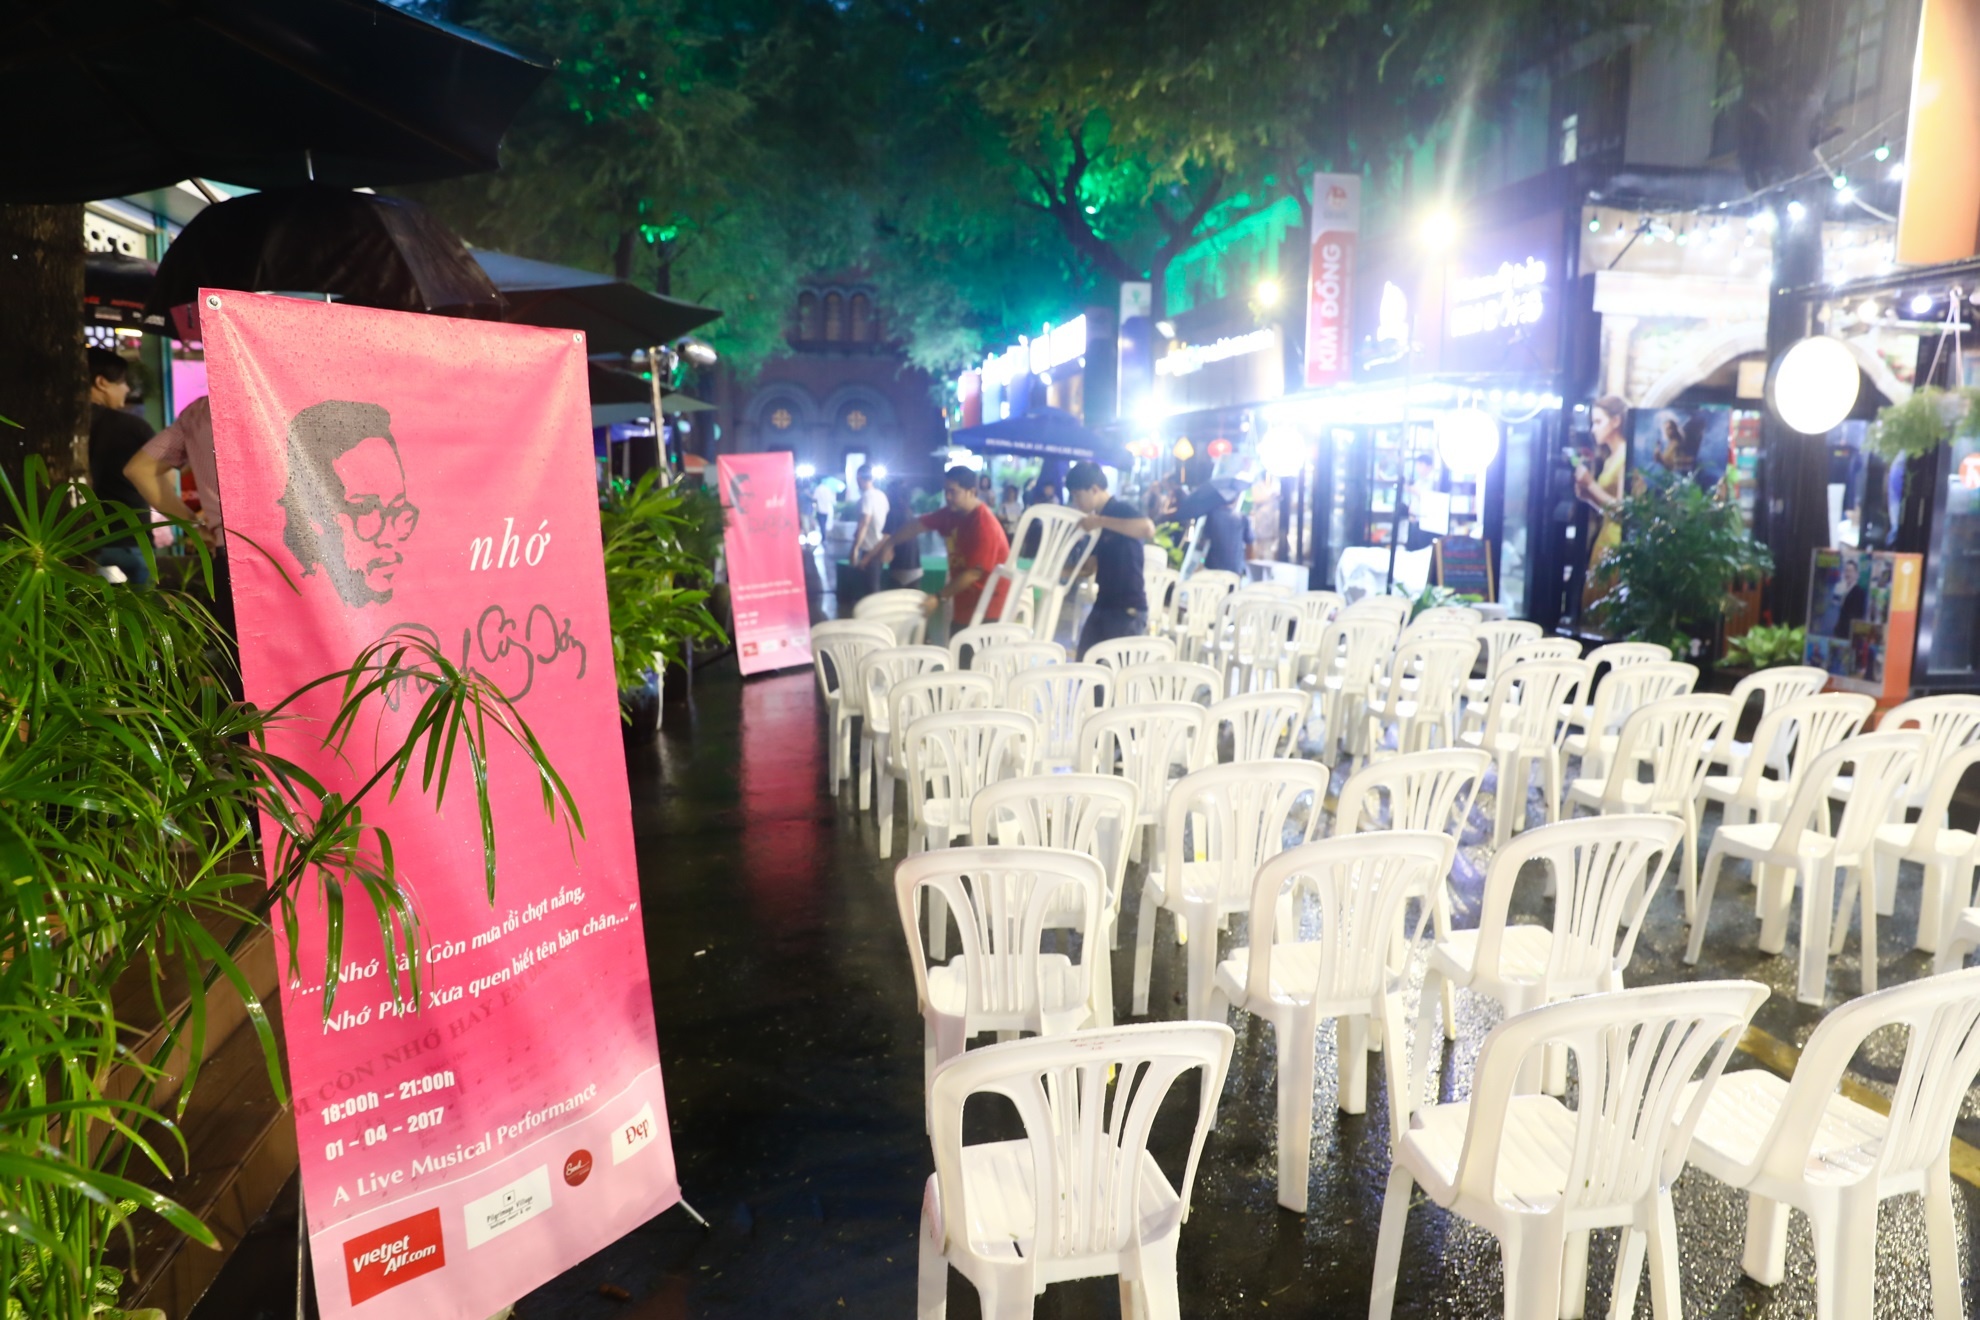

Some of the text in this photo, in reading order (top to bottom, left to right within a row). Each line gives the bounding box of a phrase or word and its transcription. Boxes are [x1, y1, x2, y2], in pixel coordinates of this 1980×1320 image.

[1317, 325, 1338, 372] KIM
[469, 516, 552, 572] nhớ
[338, 958, 380, 984] Nhớ
[425, 939, 466, 965] Gòn
[471, 925, 502, 950] mưa
[503, 909, 520, 935] rồi
[522, 898, 549, 924] chợt
[323, 1005, 373, 1036] Nhớ
[428, 984, 464, 1010] Xưa
[468, 966, 511, 999] quen
[511, 947, 535, 976] biết
[536, 941, 558, 962] tên
[557, 928, 580, 950] bàn
[320, 1091, 380, 1126] 18:00h
[398, 1070, 456, 1101] 21:00h
[324, 1138, 345, 1162] 01
[364, 1123, 388, 1147] 04
[406, 1105, 446, 1134] 2017
[332, 1185, 351, 1208] A
[356, 1168, 404, 1197] Live
[410, 1131, 493, 1179] Musical
[496, 1082, 598, 1145] Performance
[383, 1243, 437, 1277] Air.com
